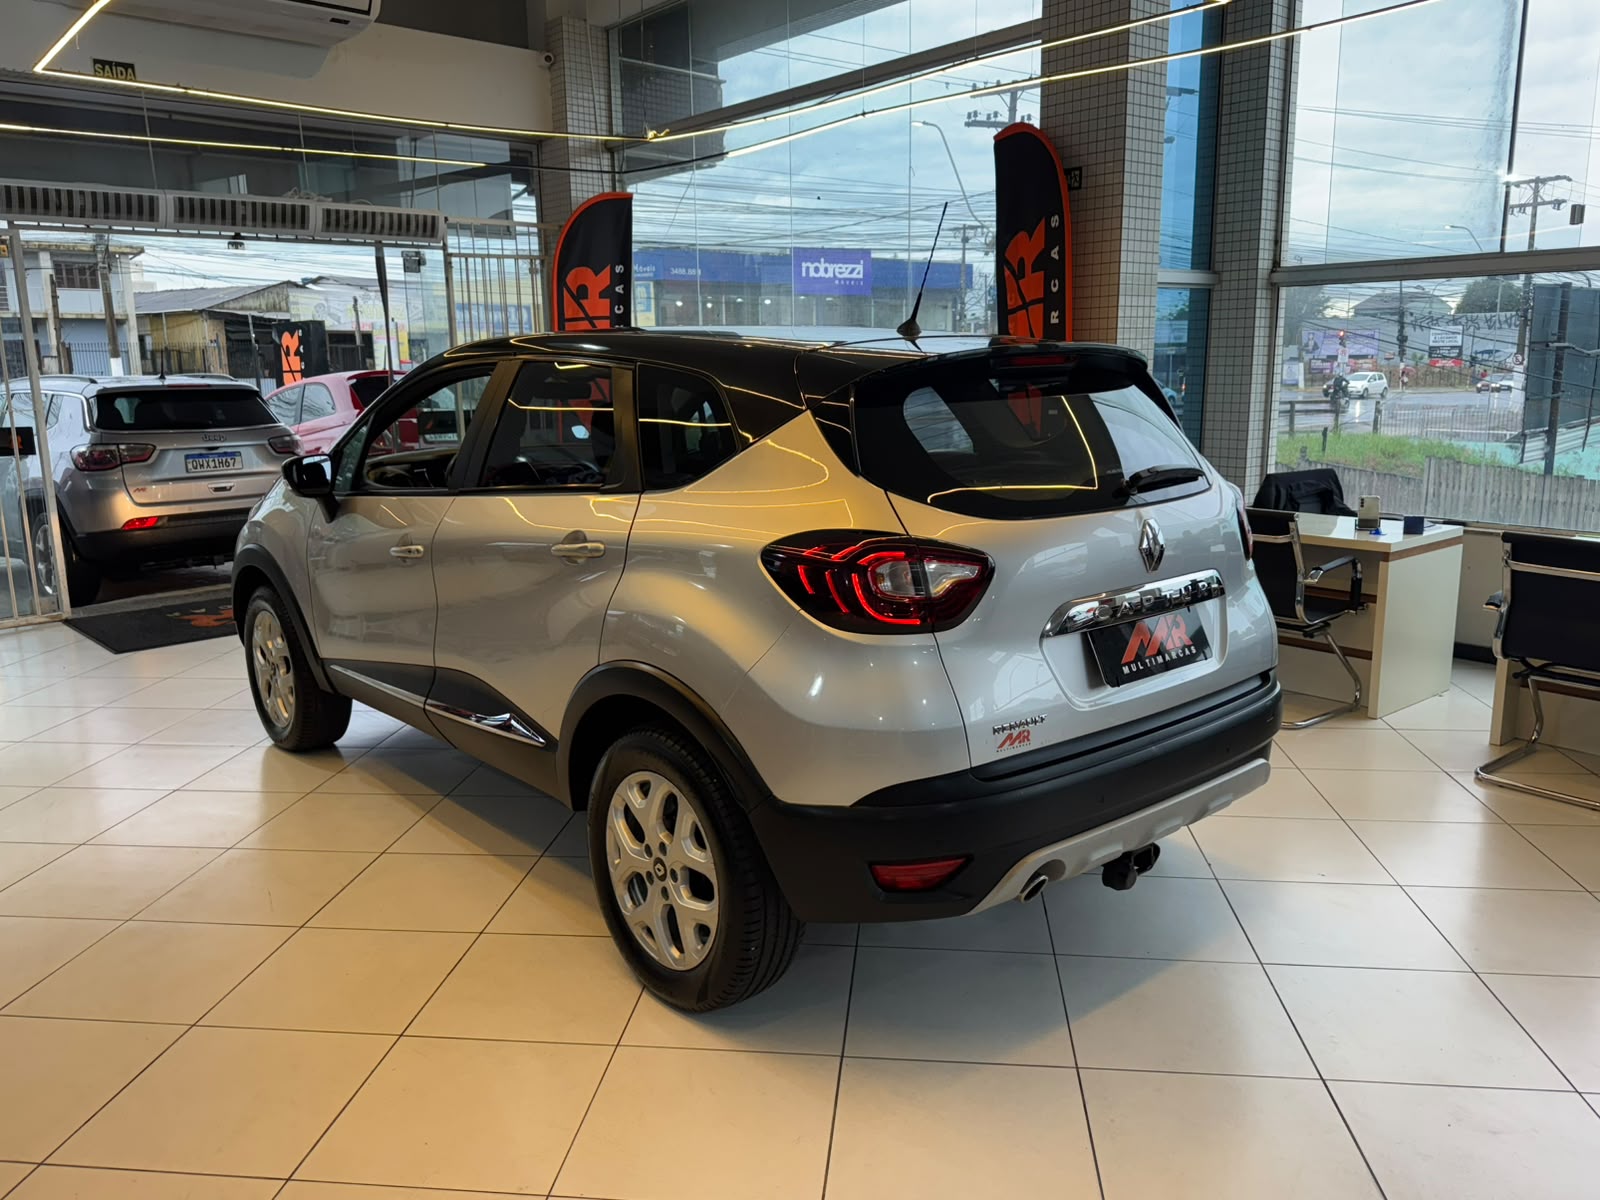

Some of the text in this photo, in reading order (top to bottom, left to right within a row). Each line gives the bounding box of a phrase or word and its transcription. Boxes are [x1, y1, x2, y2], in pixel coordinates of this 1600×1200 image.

[95, 62, 135, 81] SAÍDA
[801, 257, 864, 279] nobrezzi
[1121, 645, 1197, 675] MULTIMARCAS
